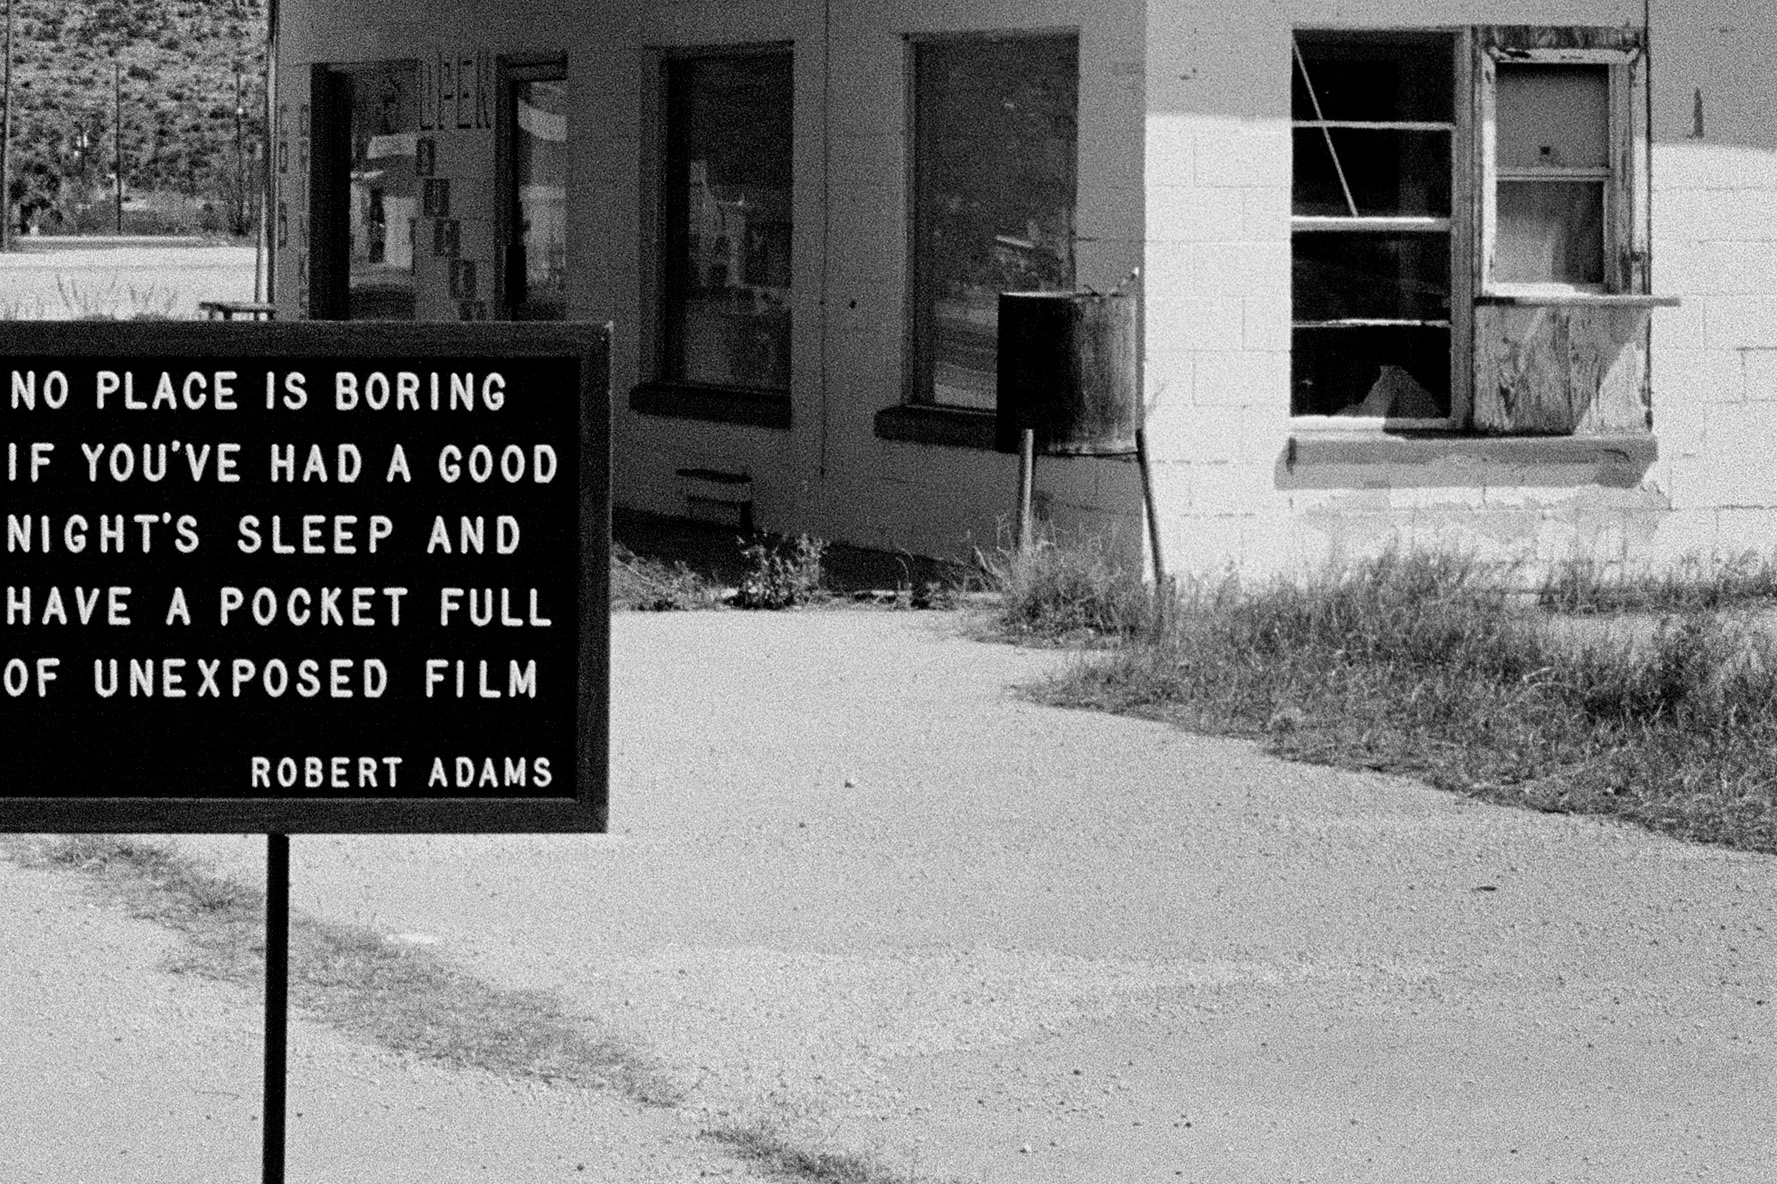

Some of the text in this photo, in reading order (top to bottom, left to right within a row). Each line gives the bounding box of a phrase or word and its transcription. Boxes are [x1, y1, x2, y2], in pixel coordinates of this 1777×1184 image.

[10, 370, 507, 413] NO PLACE IS BORING
[8, 438, 559, 484] IF YOU'VE HAD A GOOD
[7, 511, 522, 556] NIGHT'S SLEEP AND
[6, 585, 553, 628] HAVE A POCKET FULL
[3, 657, 538, 700] OF UNEXPOSED FILM
[251, 756, 554, 790] ROBERT ADAMS
